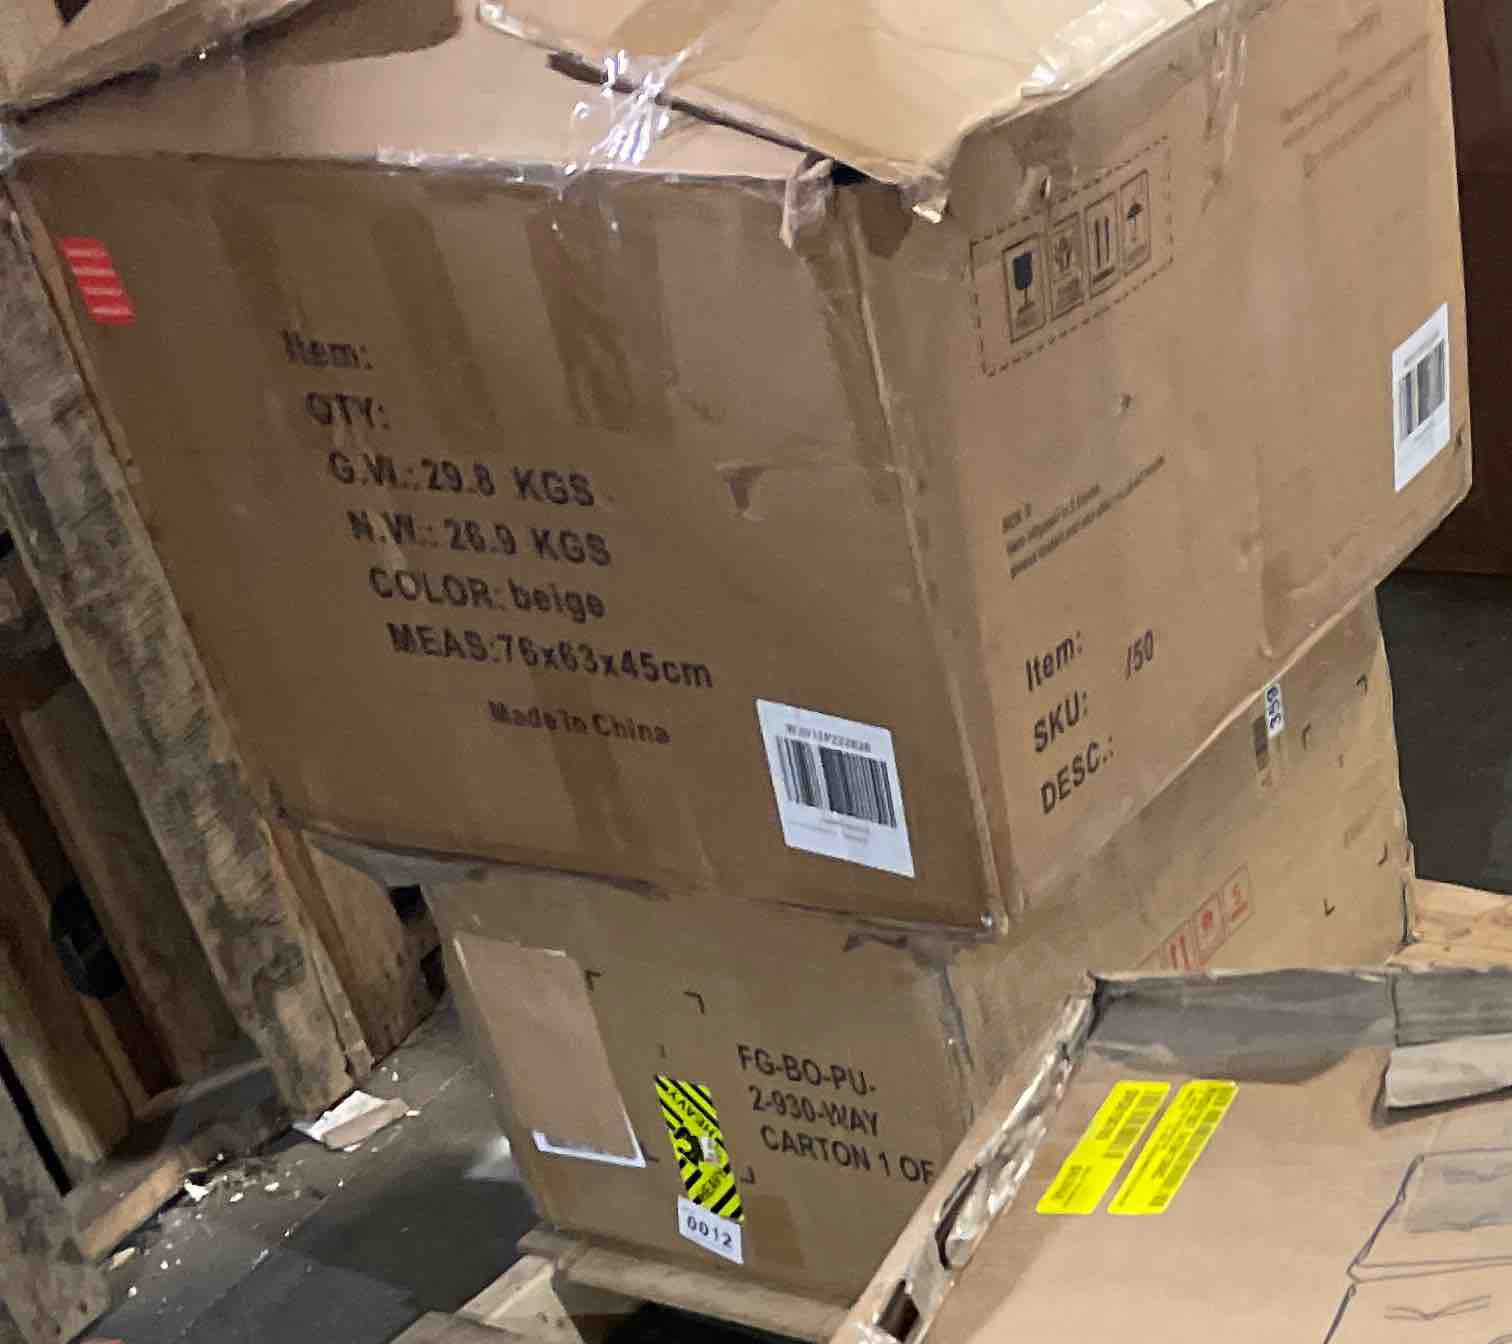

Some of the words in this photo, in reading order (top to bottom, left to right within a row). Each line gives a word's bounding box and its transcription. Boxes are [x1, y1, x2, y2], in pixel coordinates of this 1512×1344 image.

[282, 329, 373, 370] Item:
[306, 392, 390, 429] QTY:
[512, 464, 595, 506] KGS
[444, 519, 517, 555] 26.9
[530, 526, 611, 567] KGS
[508, 577, 607, 624] beige
[1026, 630, 1082, 692] Item:
[592, 713, 670, 745] China
[1034, 689, 1087, 752] SKU:
[749, 1085, 879, 1136] 2-930-WAY
[760, 1125, 870, 1171] CARTON
[879, 1152, 890, 1176] 1
[900, 1156, 935, 1184] OF
[686, 1215, 732, 1248] 0012
